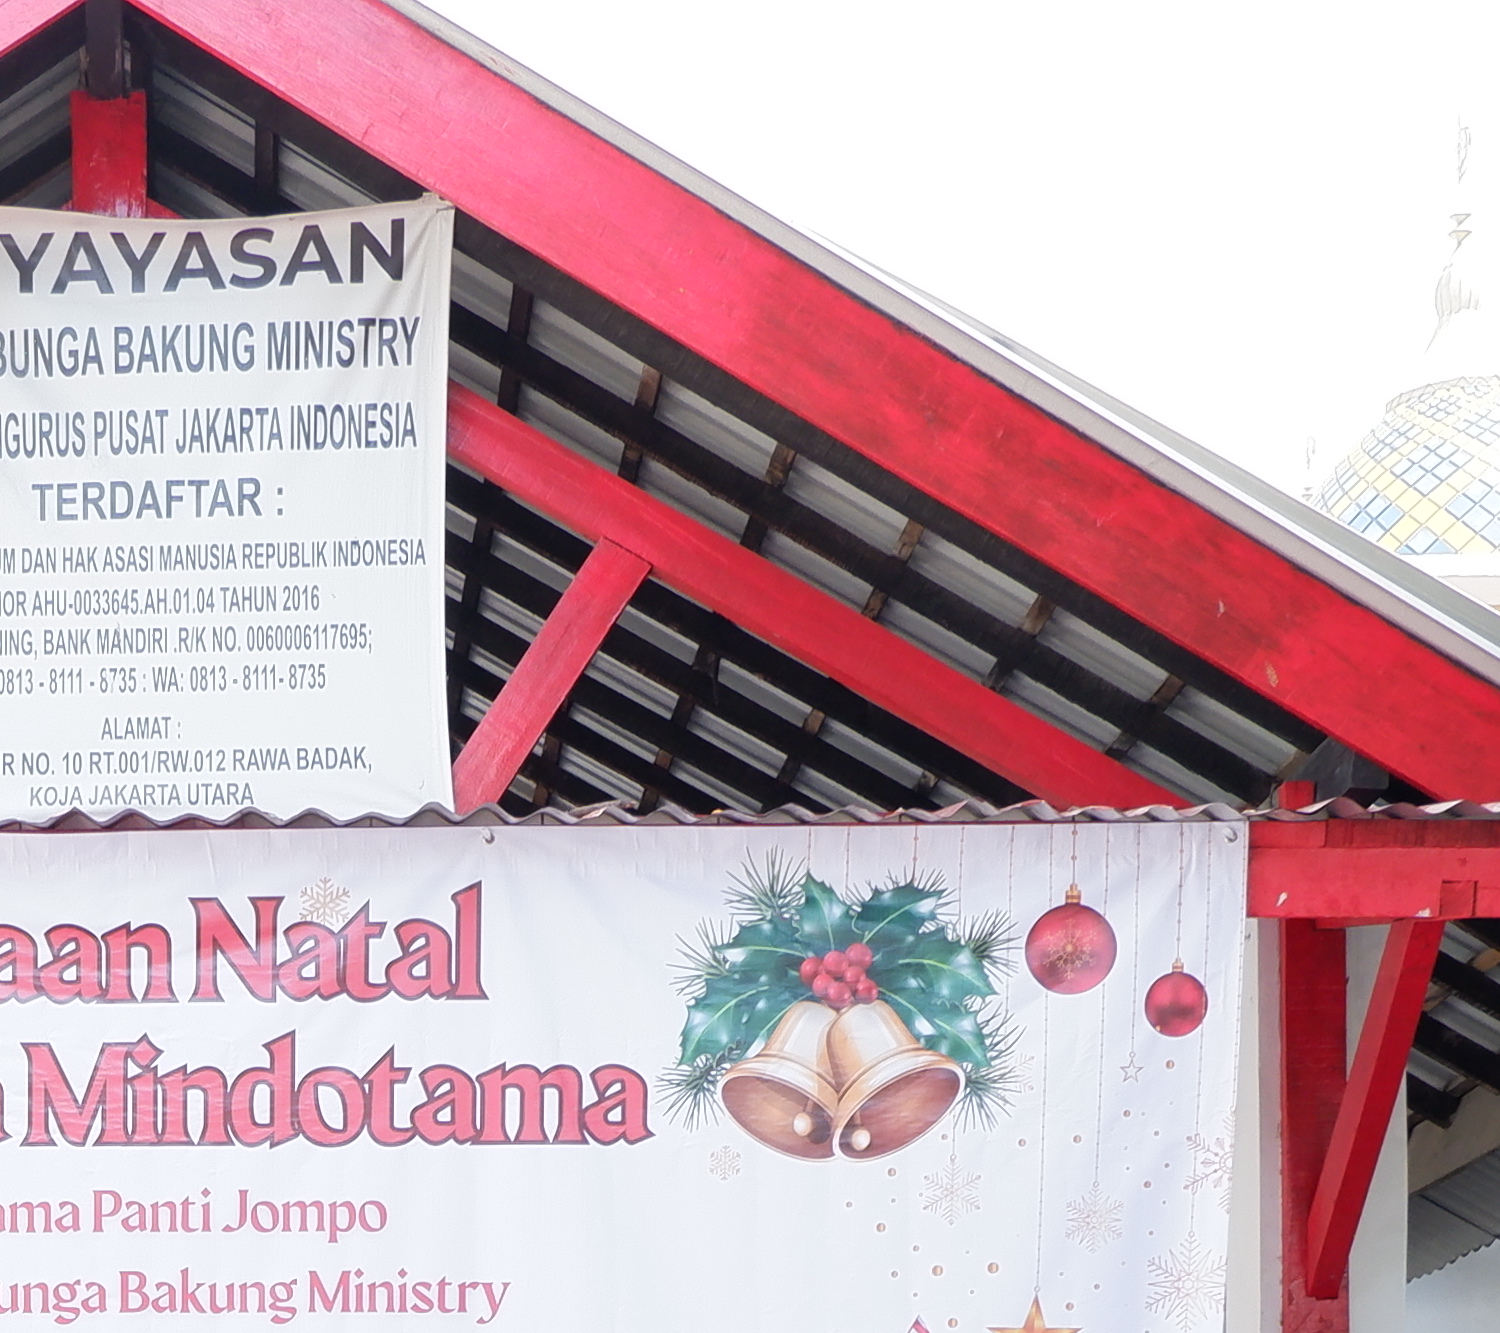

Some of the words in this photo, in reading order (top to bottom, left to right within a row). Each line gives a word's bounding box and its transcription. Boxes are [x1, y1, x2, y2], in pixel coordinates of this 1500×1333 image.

[113, 321, 255, 375] BAKUNG
[267, 315, 421, 371] MINISTRY
[93, 408, 169, 457] PUSAT
[175, 406, 284, 455] JAKARTA
[290, 401, 418, 451] INDONESIA
[31, 477, 263, 522] TERDAFTAR
[21, 546, 57, 574] DAN
[62, 545, 99, 574] HAK
[102, 545, 154, 573] ASASI
[159, 543, 238, 572] MANUSIA
[242, 540, 328, 570] REPUBLIK
[332, 538, 427, 568] INDONESIA
[31, 586, 216, 617] AHU-0033645.AH.01.04
[219, 585, 277, 614] TAHUN
[282, 584, 320, 612] 2016
[43, 628, 92, 656] BANK
[96, 623, 168, 655] MANDIRI
[212, 625, 241, 653] NO.
[246, 622, 372, 655] 0060006117695;
[48, 667, 82, 695] 8111
[99, 666, 137, 694] 8735
[189, 664, 227, 693] 0813
[288, 663, 326, 691] 8735
[100, 716, 172, 741] ALAMAT
[21, 751, 55, 776] NO.
[61, 751, 83, 776] 10
[89, 749, 226, 775] RT.001/RW.012
[232, 747, 292, 772] RAWA
[296, 745, 372, 774] BADAK,
[29, 785, 84, 809] KOJA
[88, 783, 182, 807] JAKARTA
[187, 782, 255, 806] UTARA
[187, 879, 490, 1003] Natal
[18, 1029, 657, 1150] Mindotama
[92, 1186, 212, 1234] Panti
[220, 1188, 388, 1243] Jompo
[118, 1266, 298, 1325] Bakung
[307, 1267, 512, 1325] Ministry
